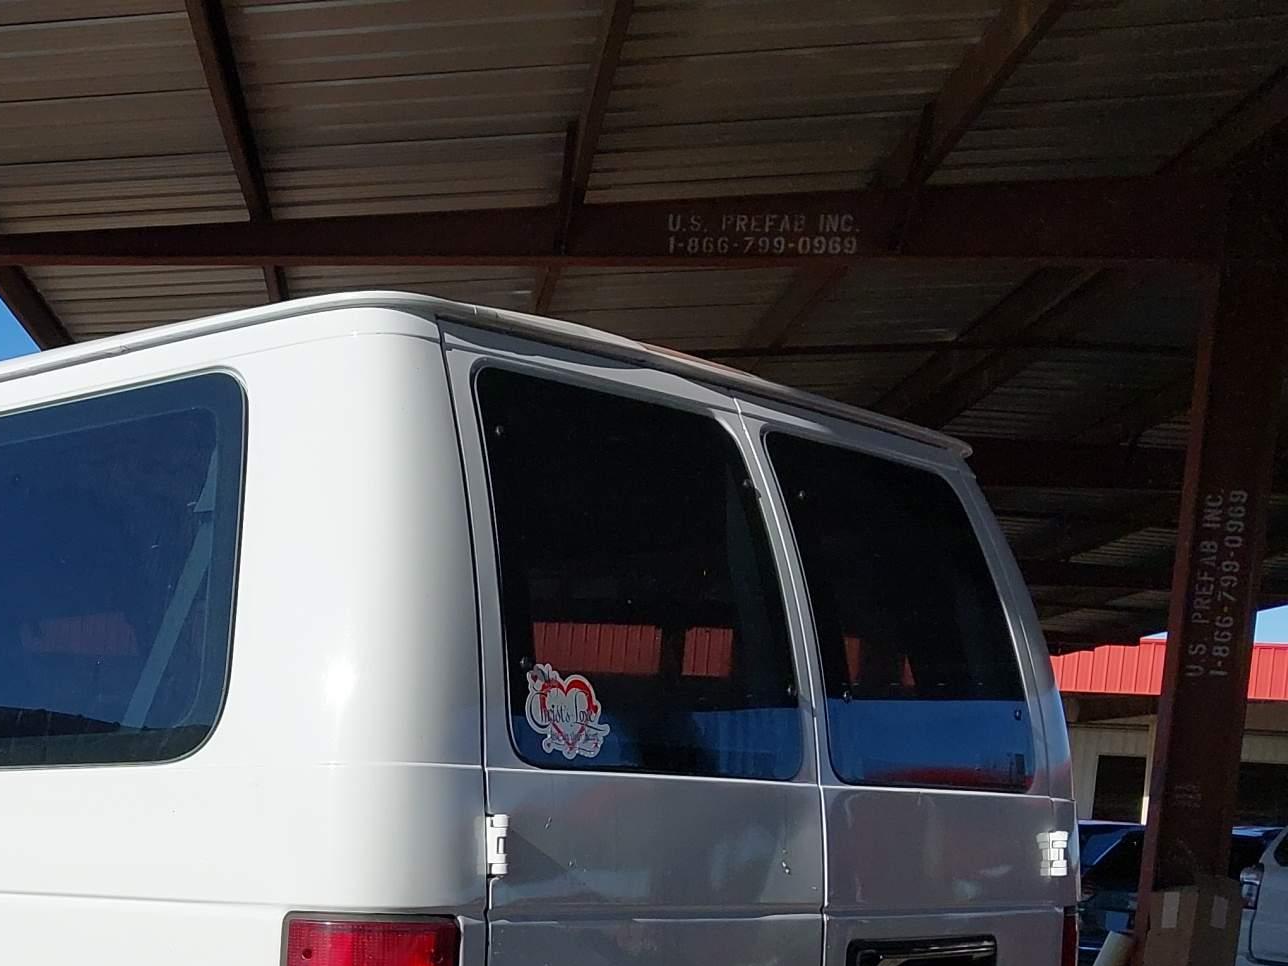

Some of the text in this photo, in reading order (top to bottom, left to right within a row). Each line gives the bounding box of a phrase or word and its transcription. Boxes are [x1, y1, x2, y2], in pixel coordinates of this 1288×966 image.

[668, 214, 861, 233] U.S. PREFAB INC.
[668, 236, 858, 255] 1-866-799-0969
[1192, 540, 1218, 624] PREFAB
[1210, 490, 1248, 675] 1-866-799-0969
